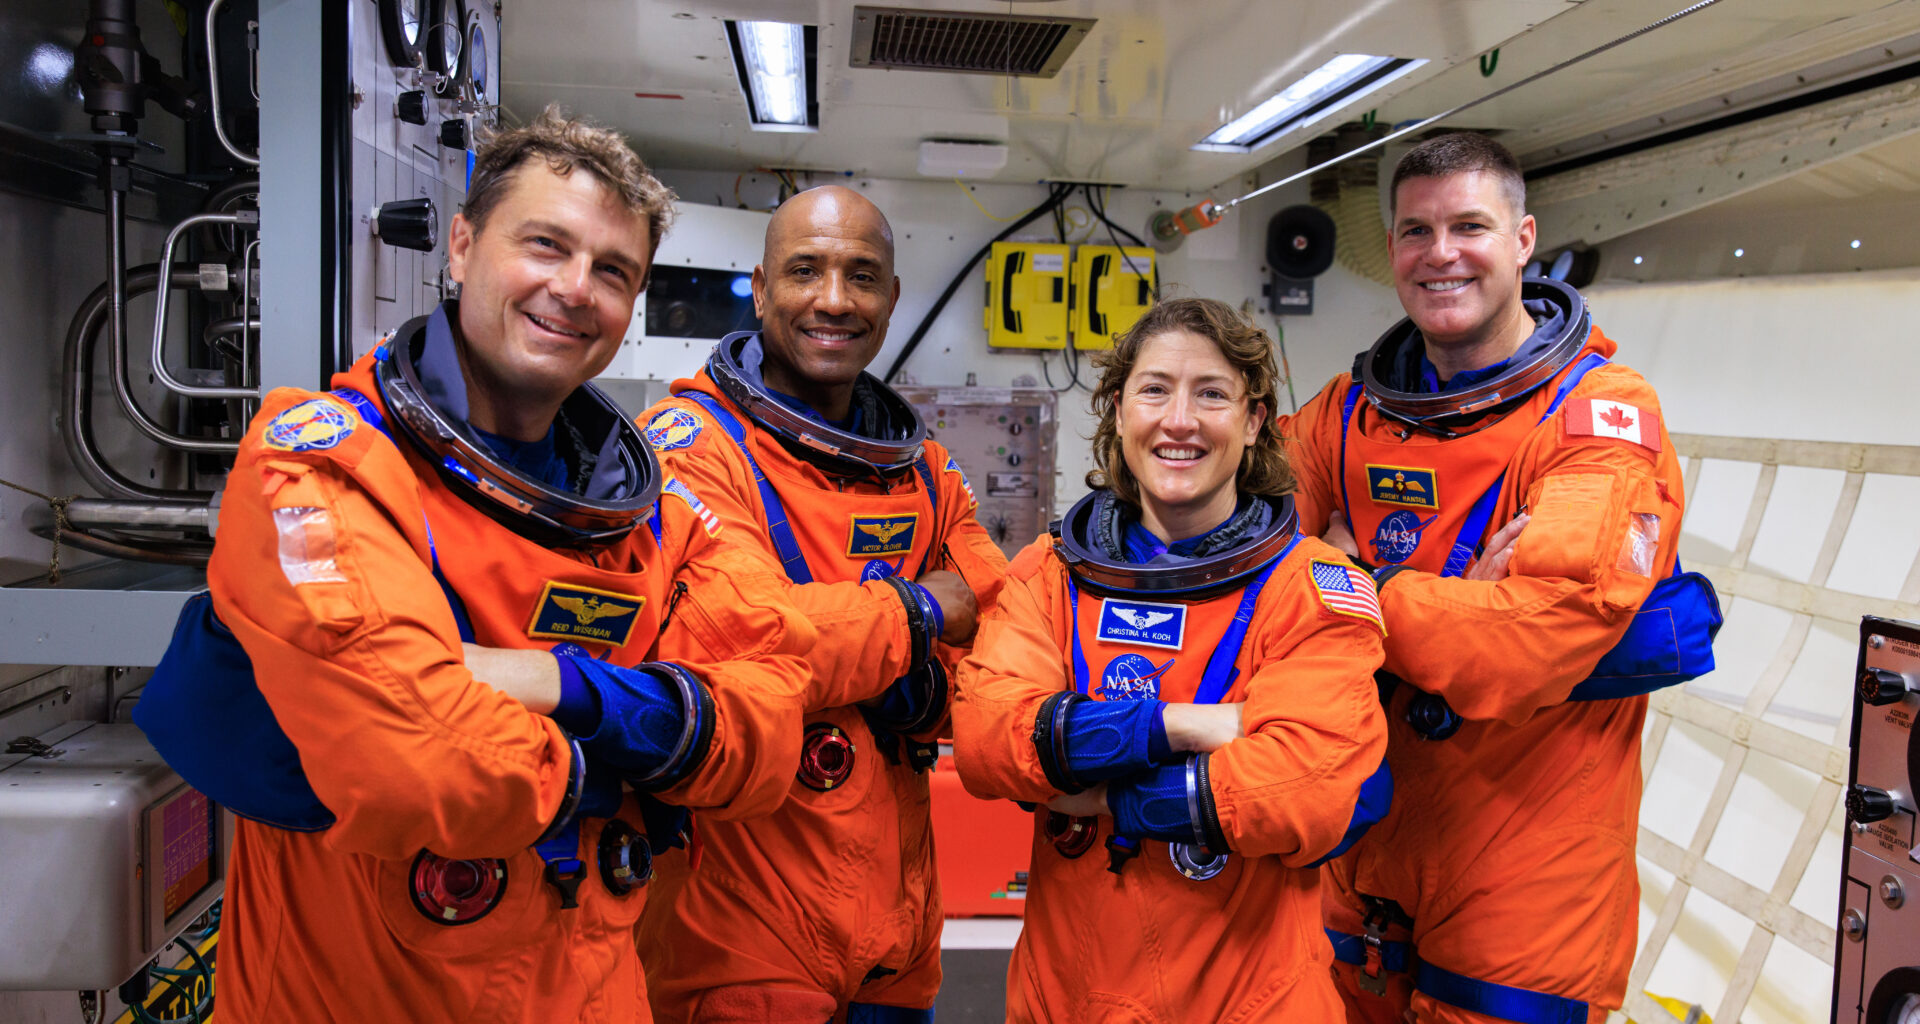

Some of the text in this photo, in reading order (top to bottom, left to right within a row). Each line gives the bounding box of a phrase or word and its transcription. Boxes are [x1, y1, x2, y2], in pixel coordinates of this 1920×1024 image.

[1379, 492, 1427, 504] JEREMY HANSEN
[1379, 528, 1417, 545] NASA
[862, 543, 902, 552] VICTOR GLOVER
[550, 622, 611, 639] REID WISEMAN
[1107, 627, 1139, 638] CHRISTINA
[1152, 632, 1171, 642] KOCH
[1106, 675, 1156, 694] NASA
[1885, 714, 1897, 724] VENT
[1879, 839, 1894, 852] VALVE
[1884, 833, 1909, 850] ISOLATION
